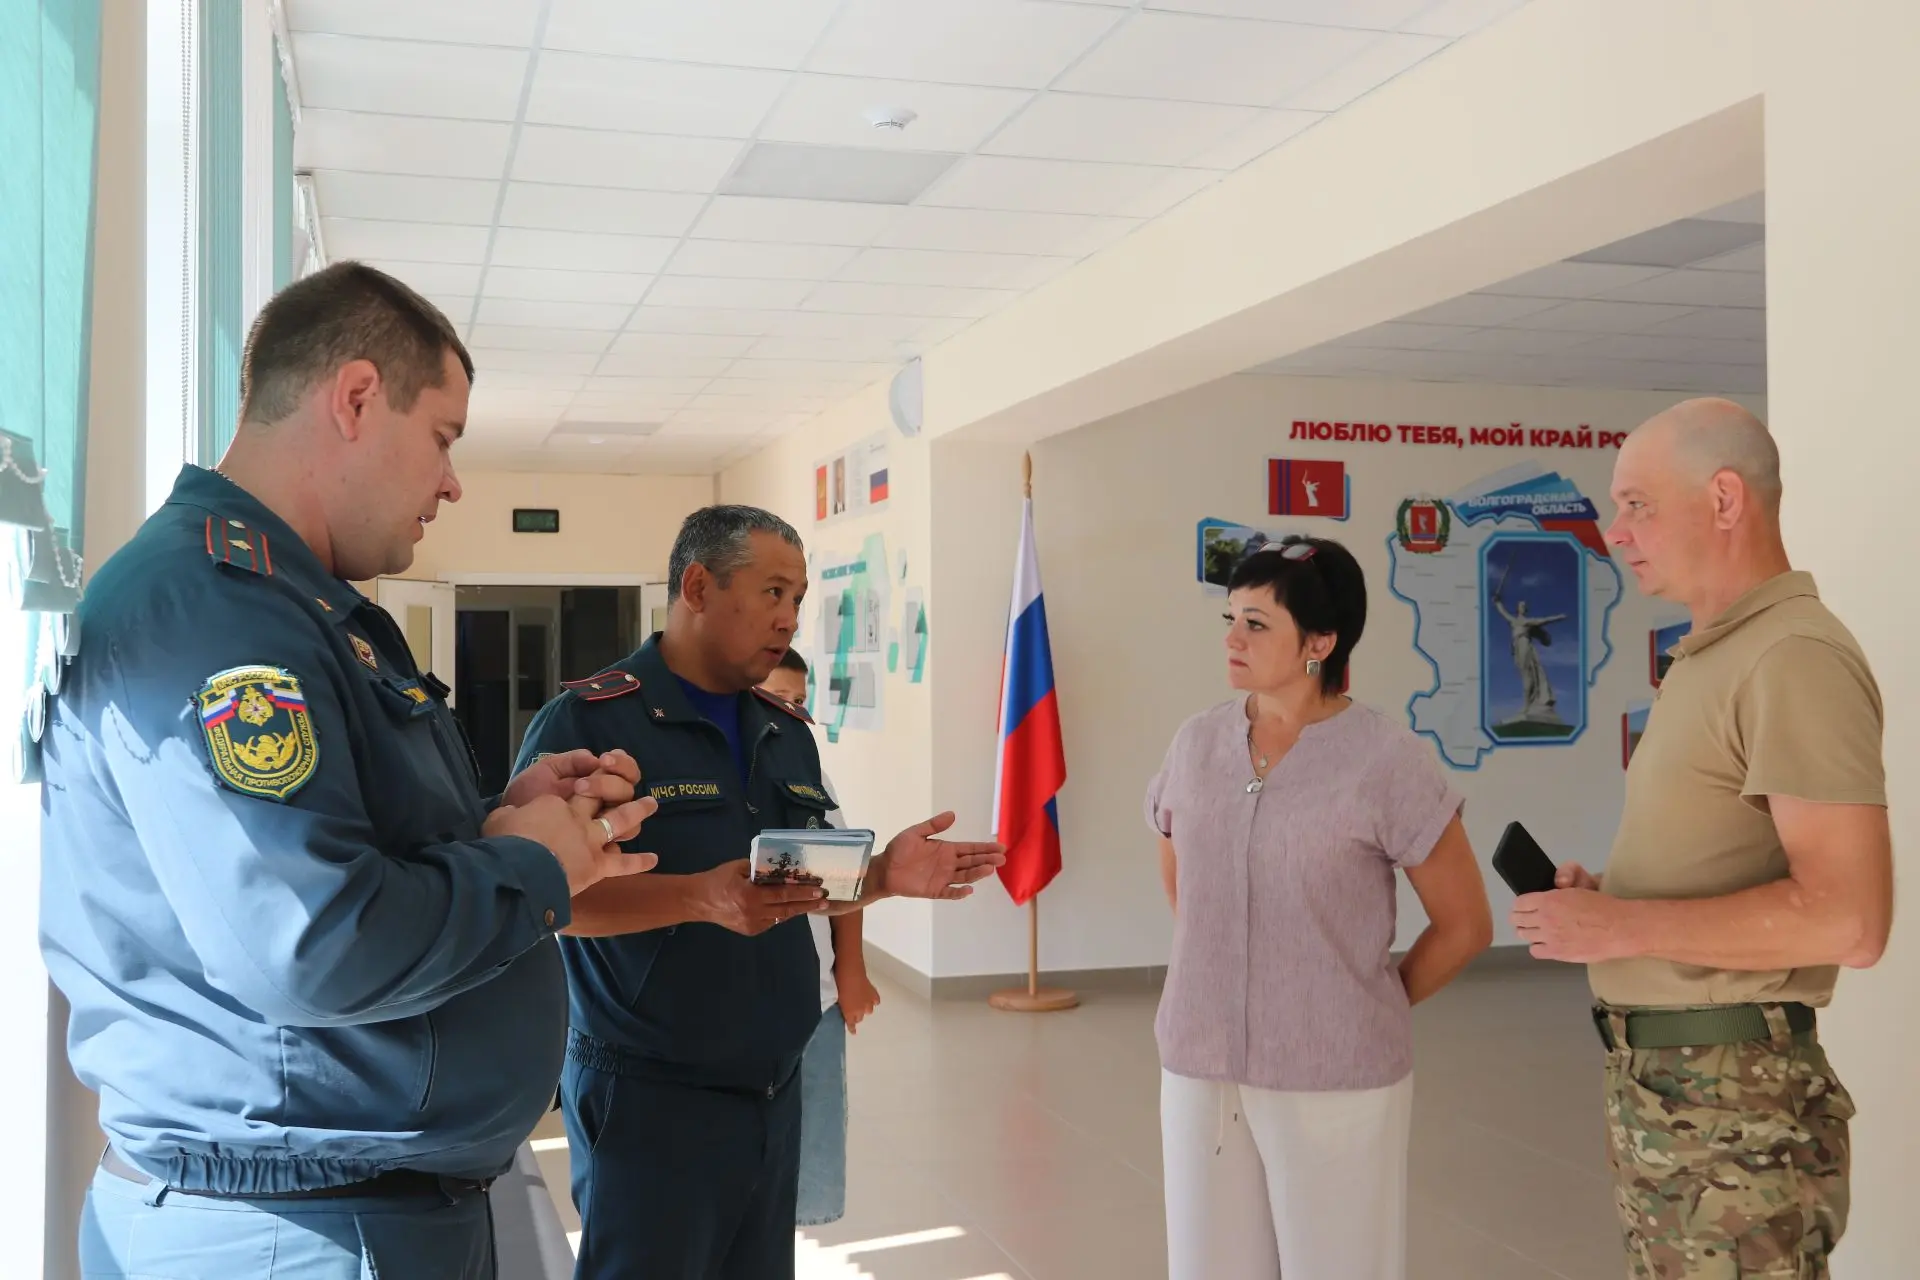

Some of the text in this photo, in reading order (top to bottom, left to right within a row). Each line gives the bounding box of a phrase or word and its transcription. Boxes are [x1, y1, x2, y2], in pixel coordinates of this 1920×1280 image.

[1289, 421, 1628, 449] ЛЮБЛЮ ТЕБЯ, МОЙ КРАЙ РО
[1468, 492, 1576, 507] ВОЛГОГРАДСКАЯ
[1531, 502, 1587, 515] ОБЛАСТЬ
[650, 783, 720, 799] МЧС РОССИИ
